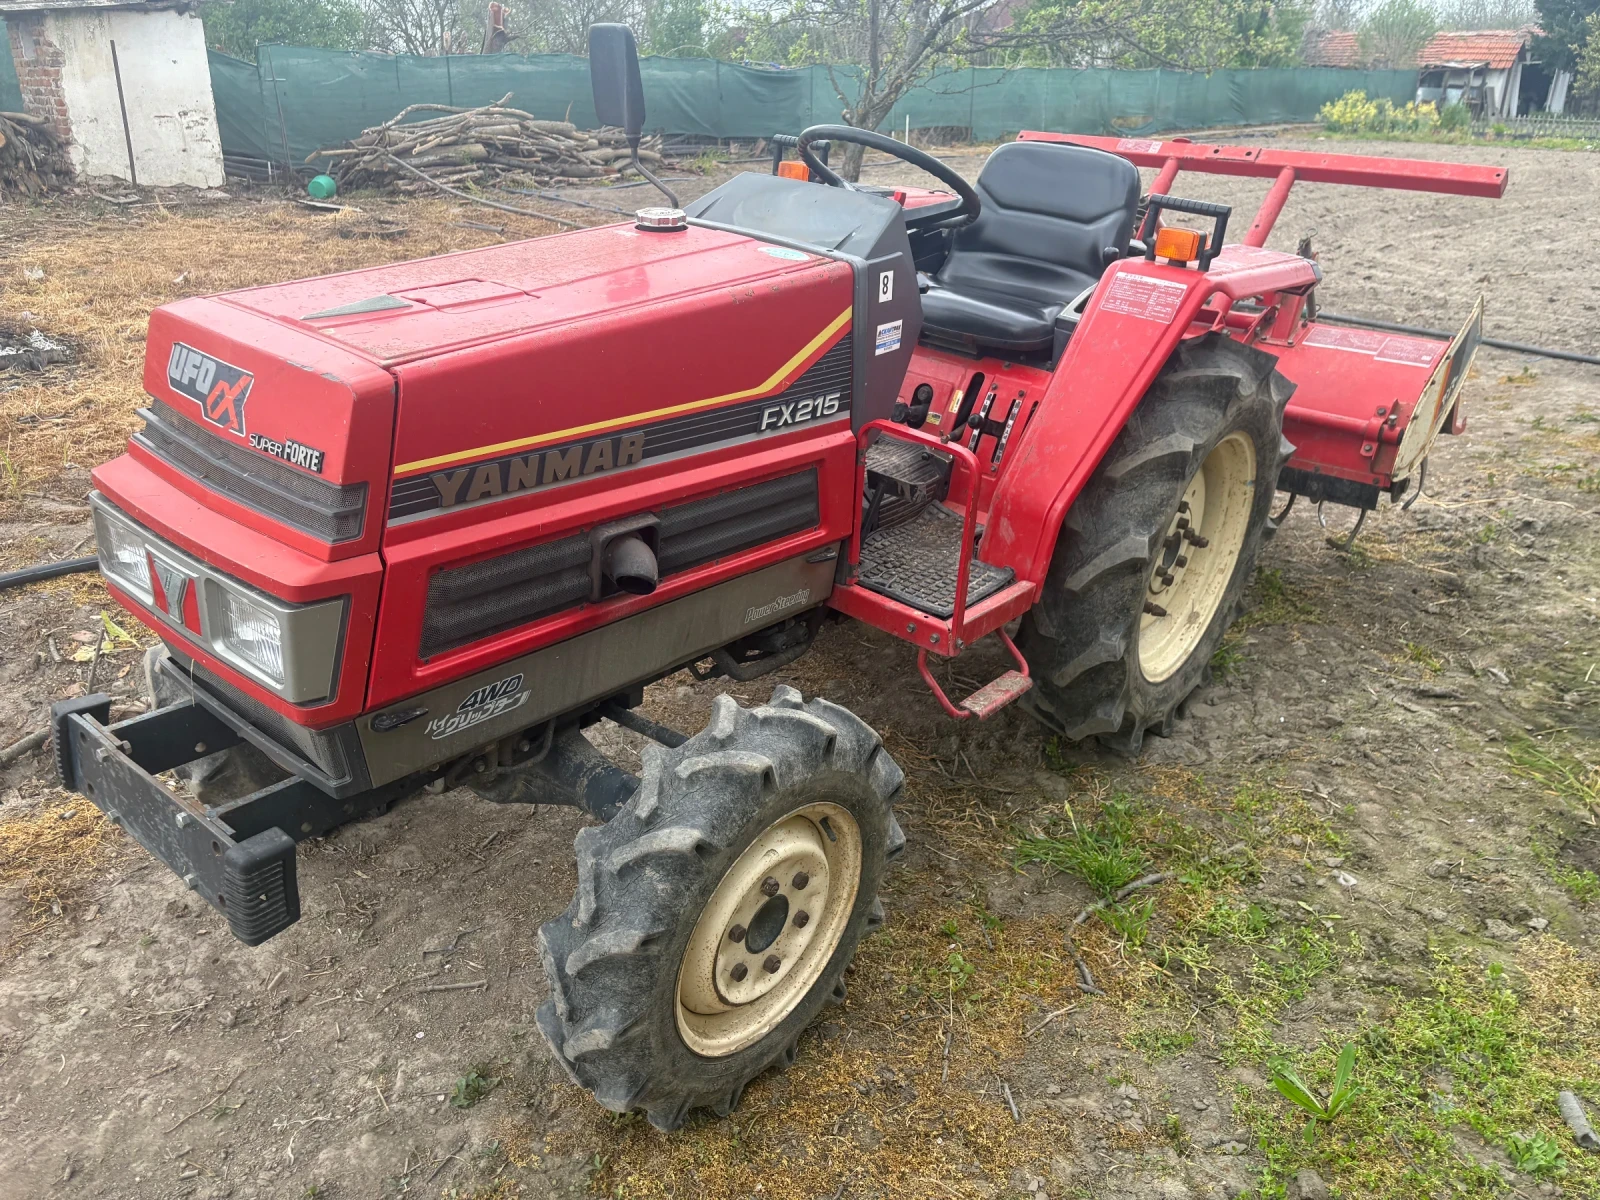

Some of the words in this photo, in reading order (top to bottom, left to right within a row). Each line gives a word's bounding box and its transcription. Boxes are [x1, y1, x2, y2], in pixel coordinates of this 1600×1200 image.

[882, 274, 889, 295] 8
[169, 344, 217, 395] UFO
[761, 392, 841, 430] FX215
[249, 433, 283, 457] SUPER
[283, 440, 320, 472] FORTE
[431, 431, 645, 508] YANMAR
[457, 673, 524, 713] 4WD
